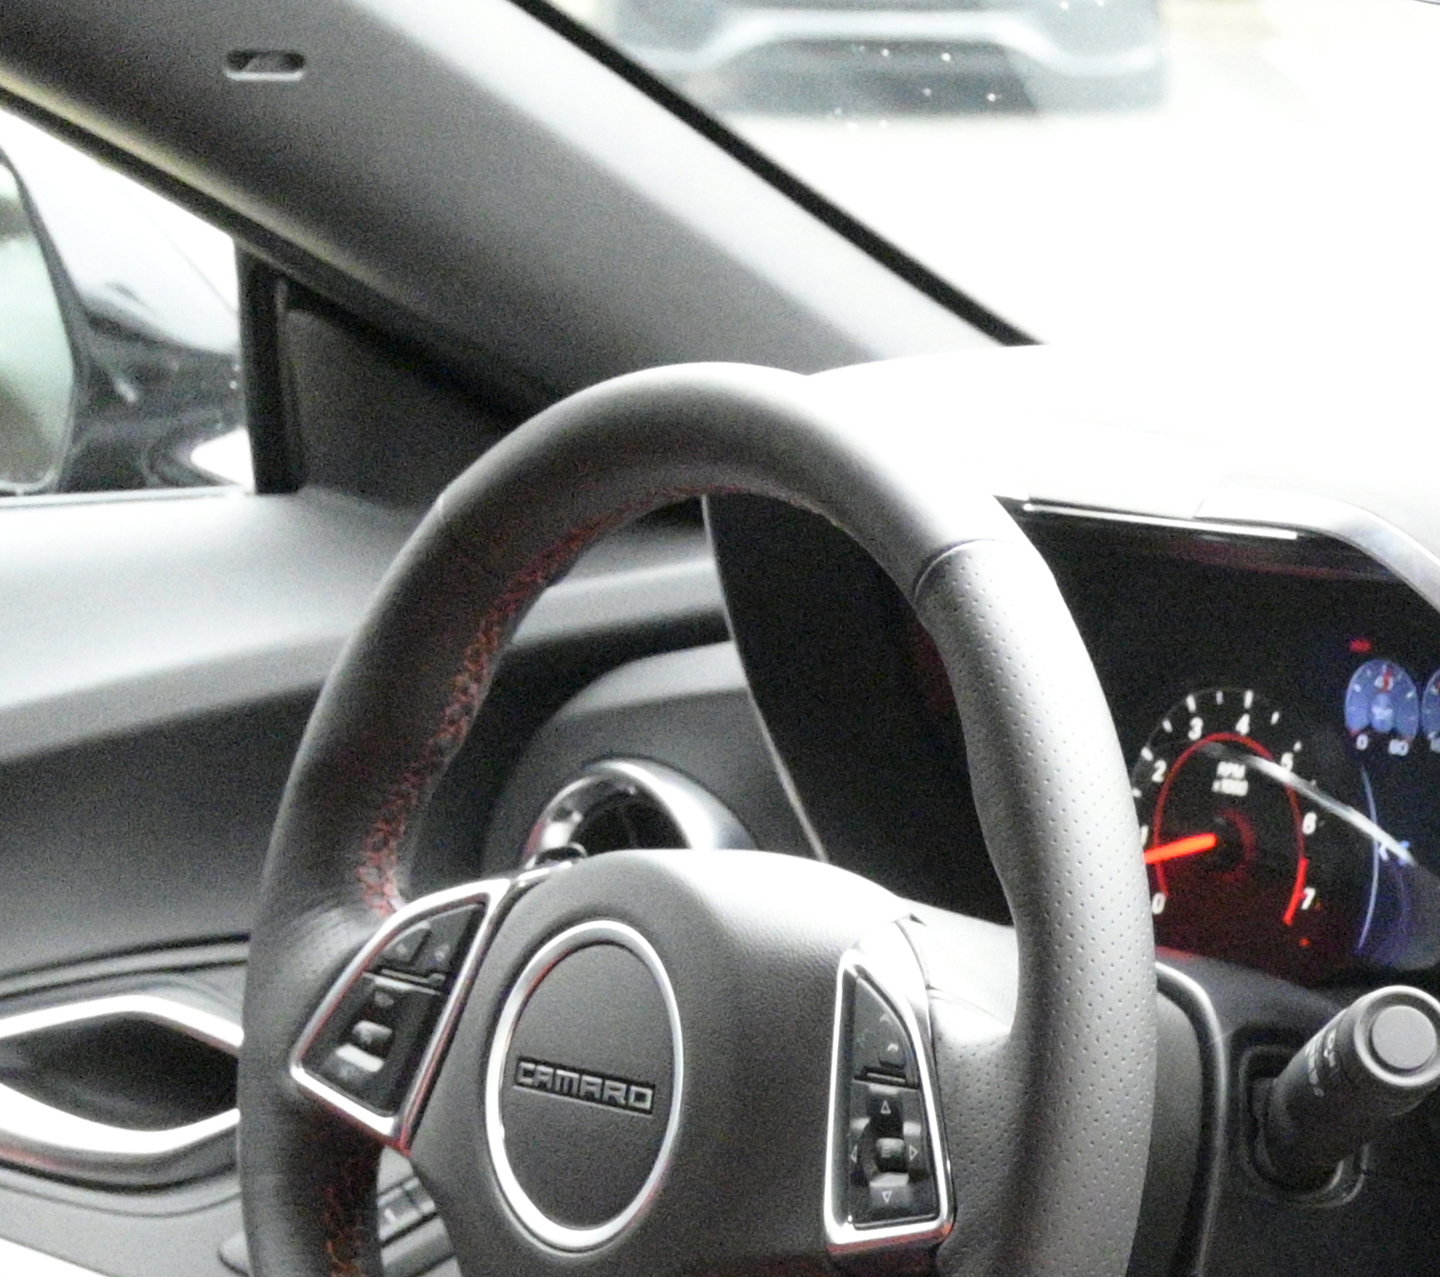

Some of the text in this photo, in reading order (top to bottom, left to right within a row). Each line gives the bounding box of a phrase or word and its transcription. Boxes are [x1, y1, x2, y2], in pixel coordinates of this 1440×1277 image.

[1188, 717, 1204, 740] 3
[1235, 713, 1250, 736] 4
[1151, 759, 1167, 783] 2
[1301, 811, 1318, 835] 6
[518, 1060, 653, 1111] CAMARO
